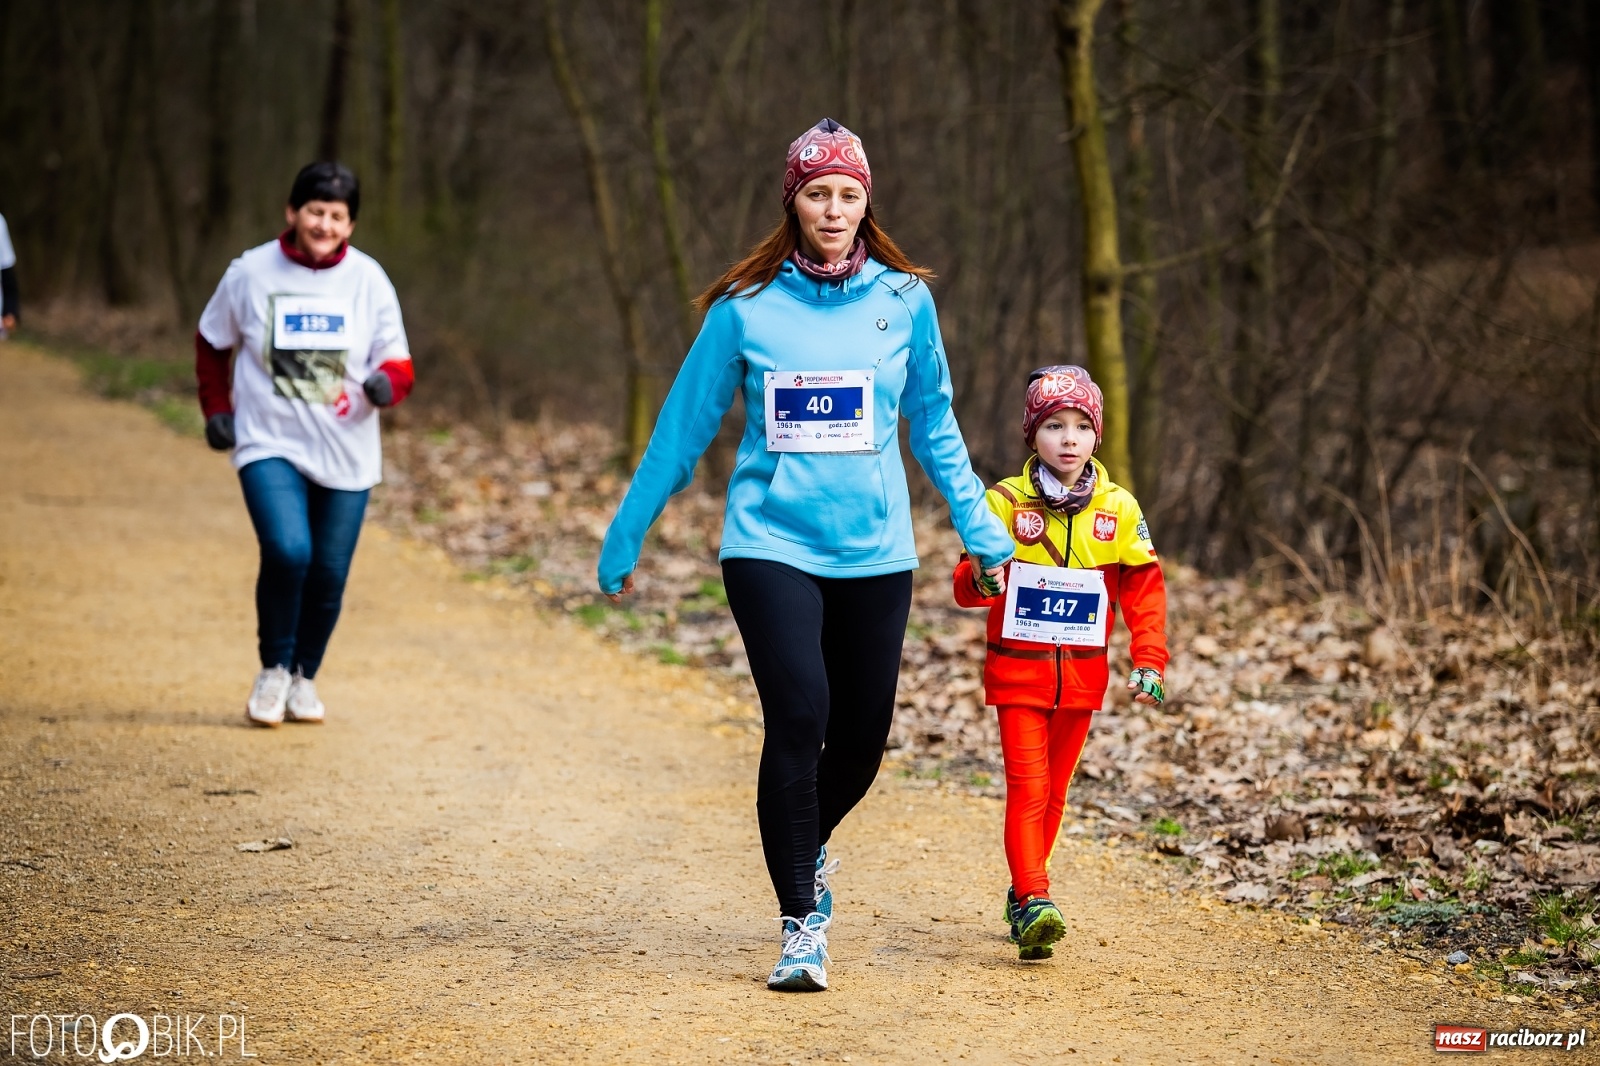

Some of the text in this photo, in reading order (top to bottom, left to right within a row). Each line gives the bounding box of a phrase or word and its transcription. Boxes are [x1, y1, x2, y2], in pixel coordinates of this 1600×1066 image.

[804, 147, 813, 157] B
[806, 395, 833, 414] 40
[1041, 597, 1078, 617] 147
[1015, 619, 1031, 627] 1963
